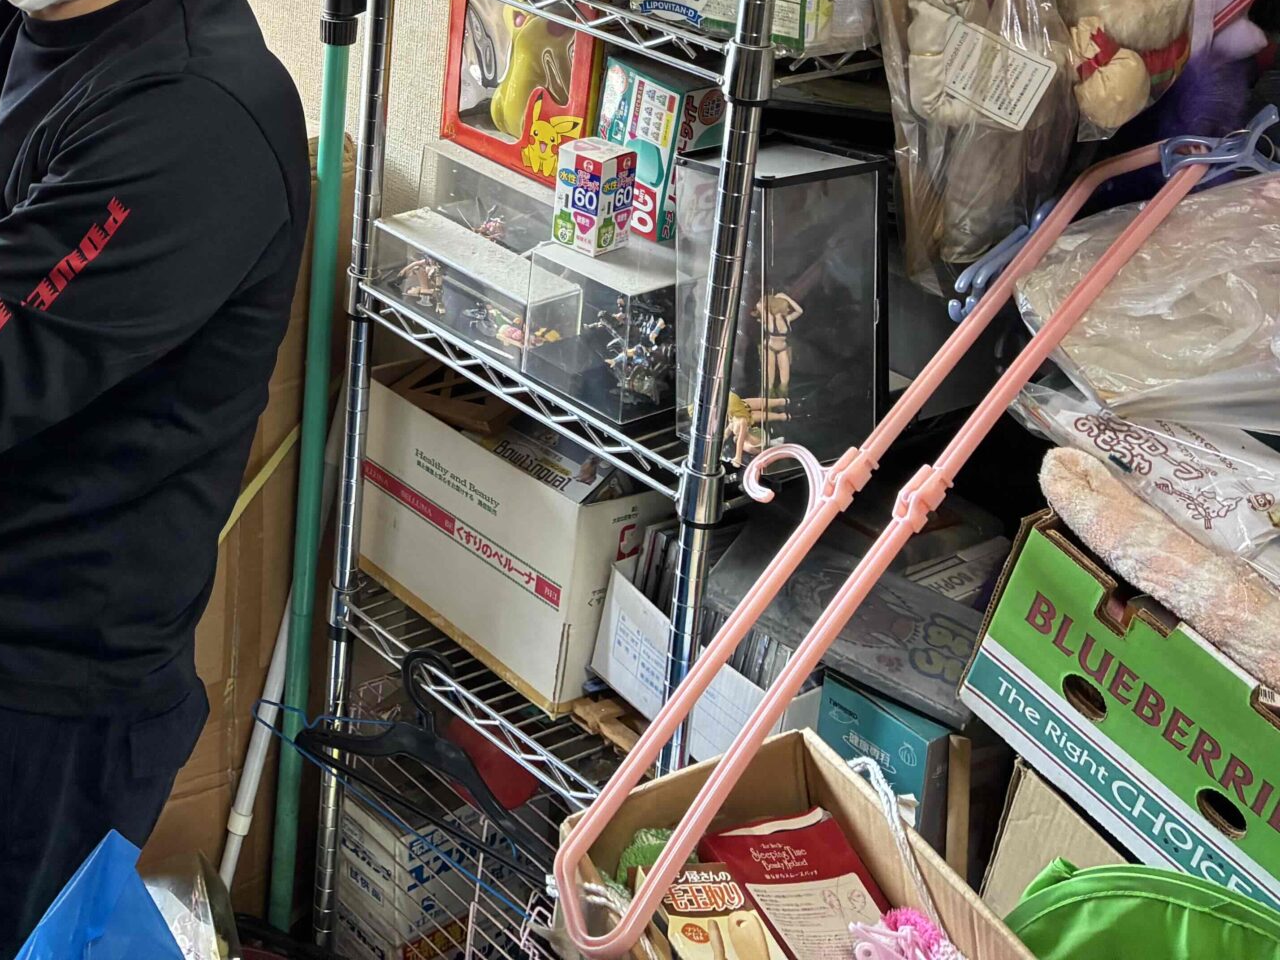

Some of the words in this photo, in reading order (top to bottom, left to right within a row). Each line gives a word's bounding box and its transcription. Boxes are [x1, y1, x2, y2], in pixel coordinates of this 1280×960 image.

[574, 187, 598, 211] 60
[614, 185, 633, 208] 60
[21, 196, 131, 312] POWE
[1073, 414, 1153, 476] おもちゃ
[414, 447, 450, 478] Healthy
[450, 470, 468, 486] and
[468, 481, 502, 509] Beauty
[455, 525, 536, 586] くすりのベルーナ
[996, 677, 1041, 725] The
[1043, 712, 1109, 786] Right
[664, 881, 746, 913] 毛玉取り
